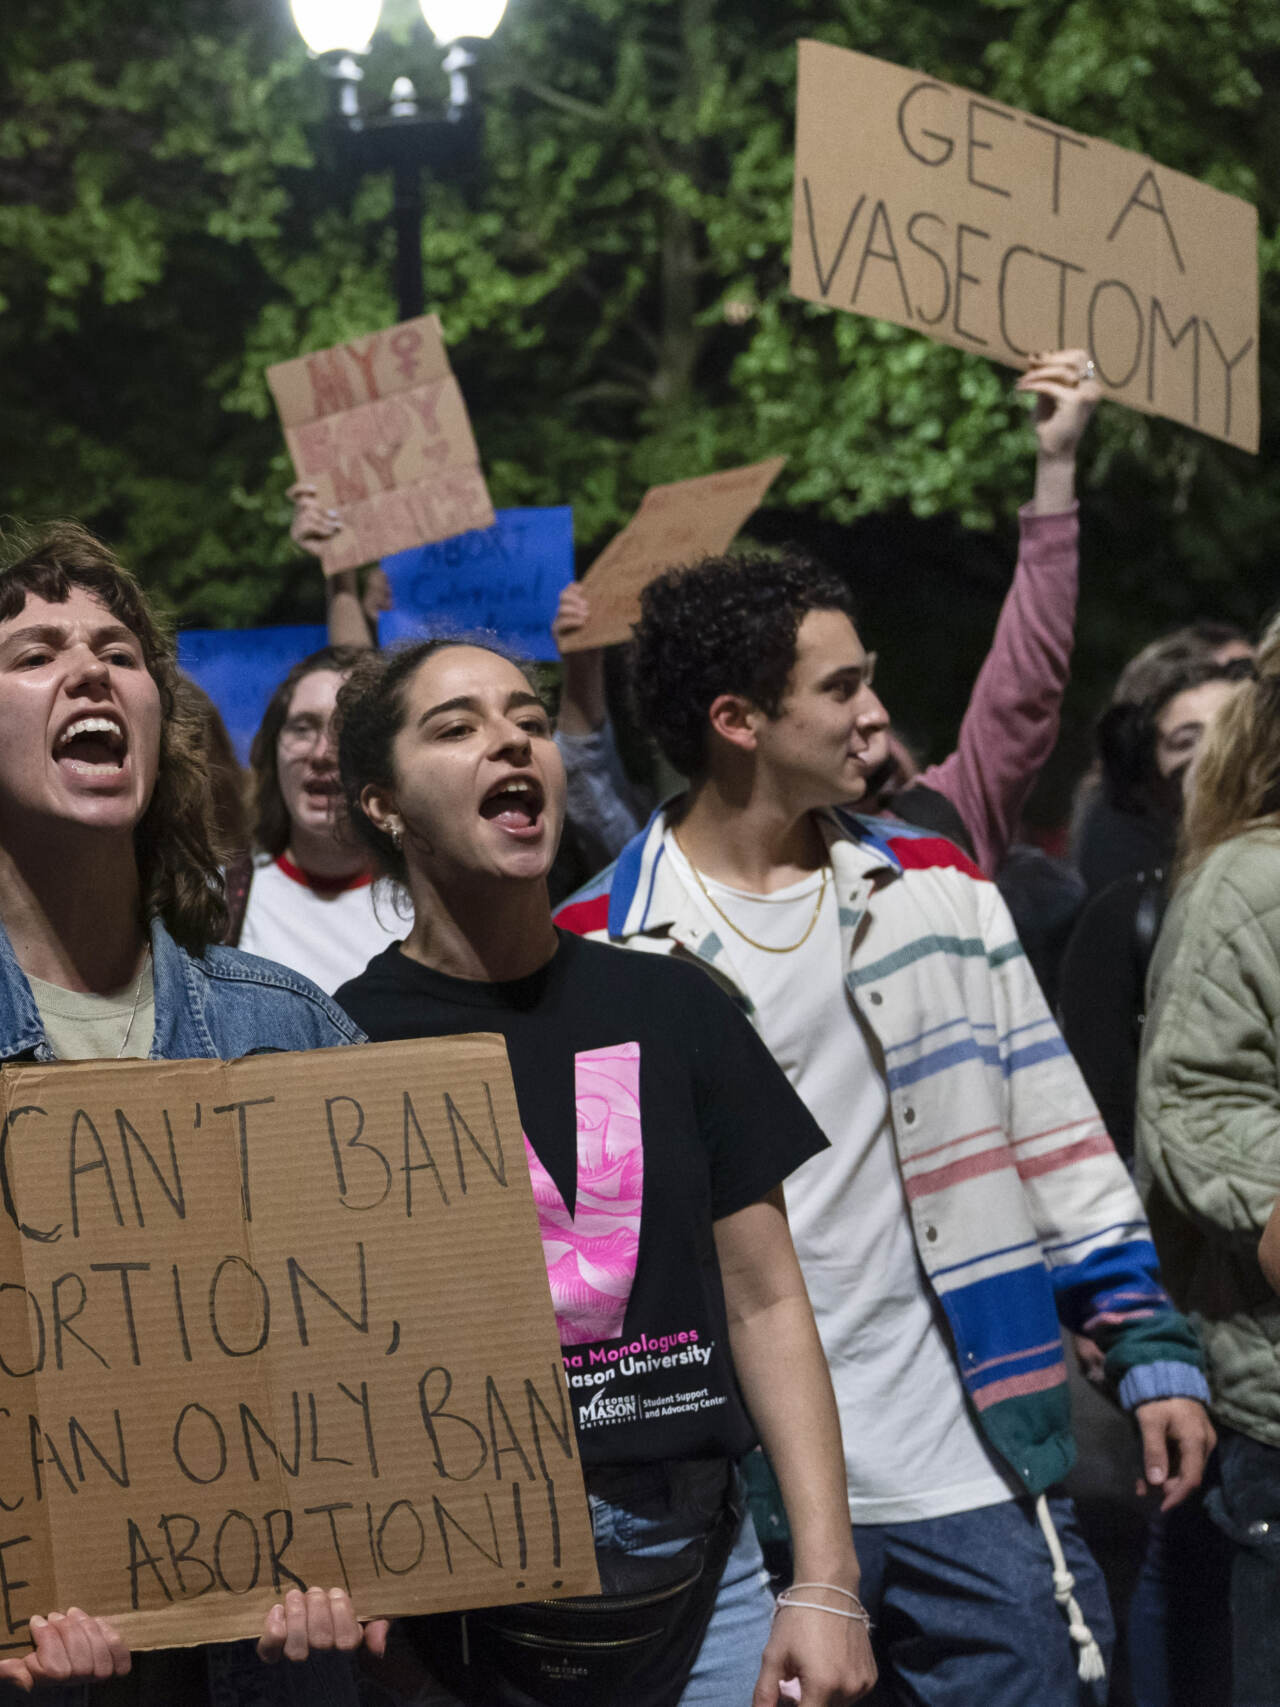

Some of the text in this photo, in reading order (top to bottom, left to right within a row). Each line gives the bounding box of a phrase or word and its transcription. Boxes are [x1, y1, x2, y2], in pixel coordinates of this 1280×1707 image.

[897, 82, 1186, 274] GET A
[802, 176, 1254, 437] VASECTOMY
[0, 1096, 275, 1243] CAN'T
[325, 1081, 508, 1217] BAN
[589, 1329, 699, 1365] Monologues
[619, 1344, 712, 1376] University
[579, 1402, 636, 1423] MASON
[598, 1395, 635, 1406] GEORGE
[643, 1388, 709, 1408] Student Support
[645, 1408, 660, 1418] and
[661, 1402, 699, 1415] Advocacy
[173, 1382, 379, 1484] ONLY
[418, 1363, 573, 1483] BAN
[127, 1481, 563, 1610] ABORTION!!
